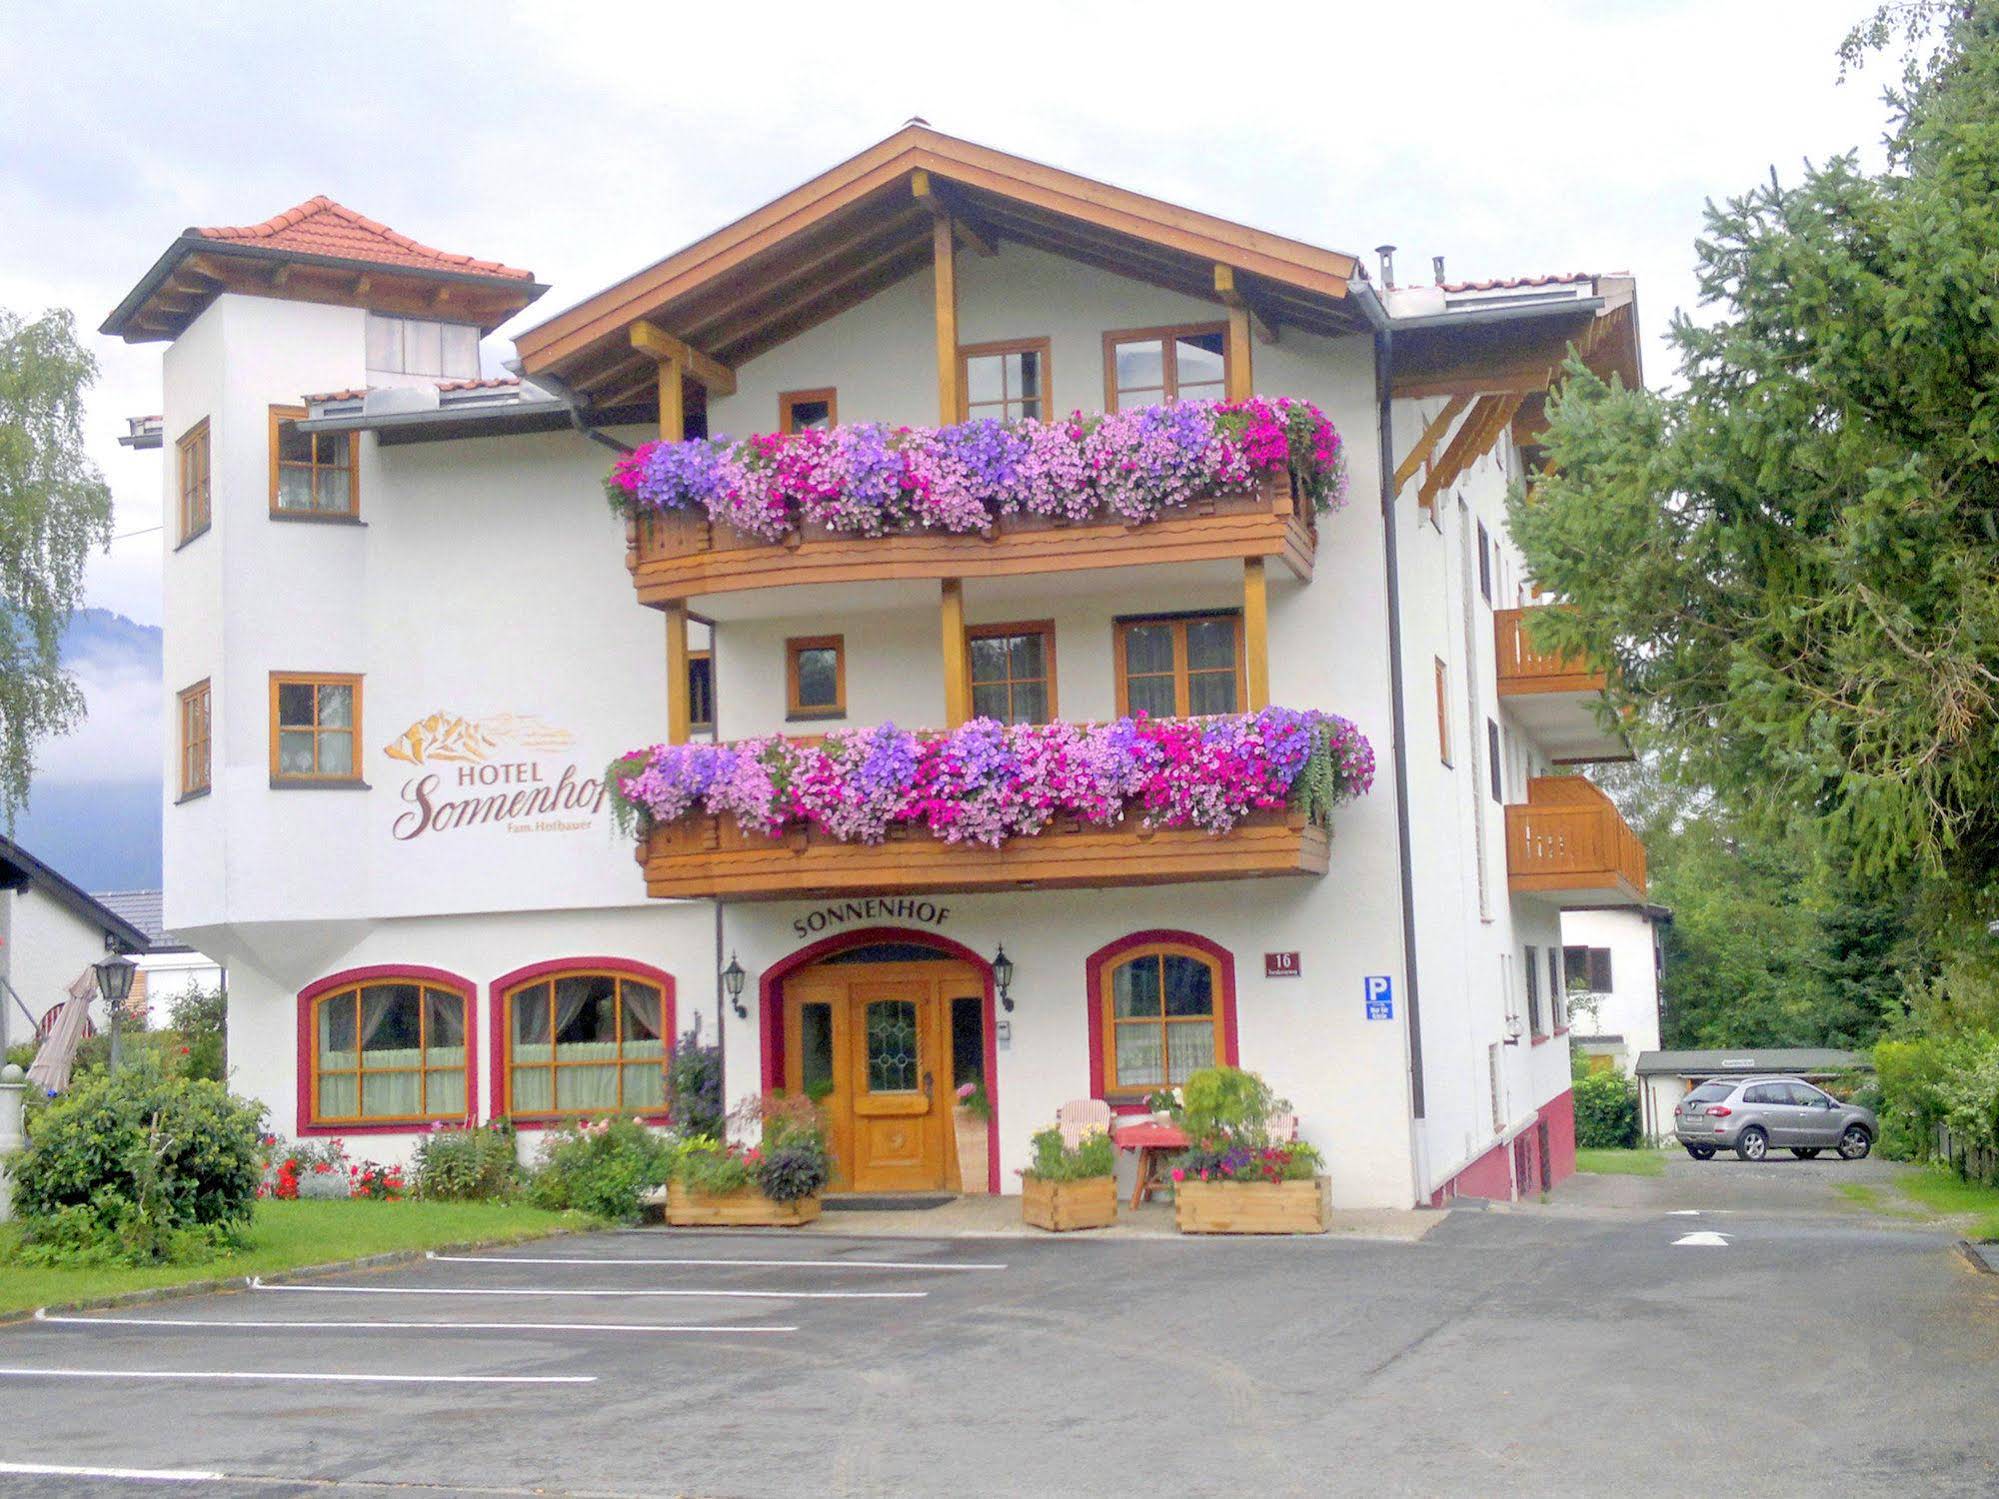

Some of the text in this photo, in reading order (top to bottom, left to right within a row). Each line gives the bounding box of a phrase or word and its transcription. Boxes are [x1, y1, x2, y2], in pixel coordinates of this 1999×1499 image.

[458, 762, 543, 786] HOTEL
[793, 899, 950, 939] SONNENHOF
[1276, 953, 1291, 968] 16
[1368, 977, 1387, 1001] P
